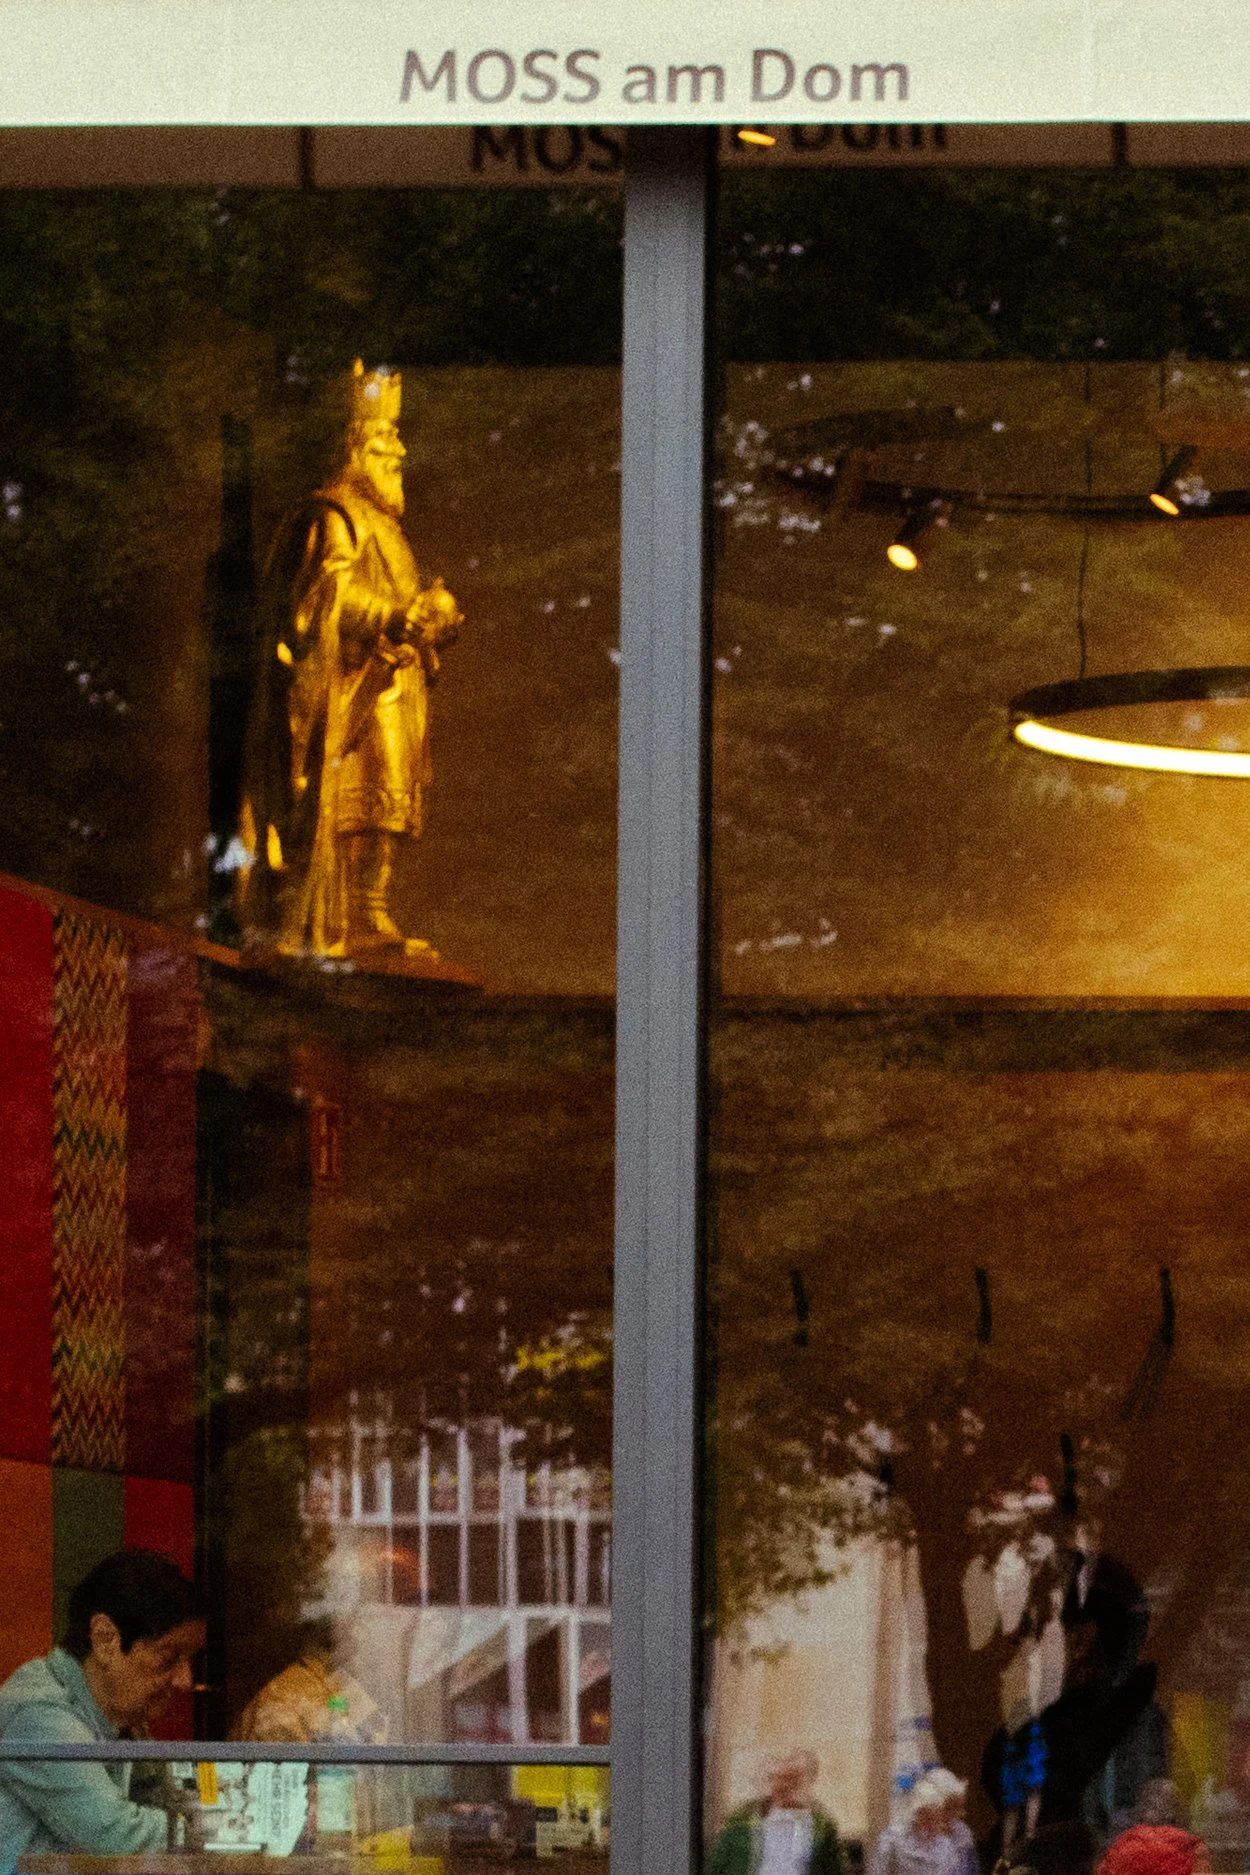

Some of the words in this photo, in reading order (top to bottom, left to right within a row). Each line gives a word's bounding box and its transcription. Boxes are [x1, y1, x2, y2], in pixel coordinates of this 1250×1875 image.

[399, 48, 601, 103] MOSS
[622, 63, 726, 103] am
[751, 48, 909, 103] Dom
[470, 125, 627, 174] MOS
